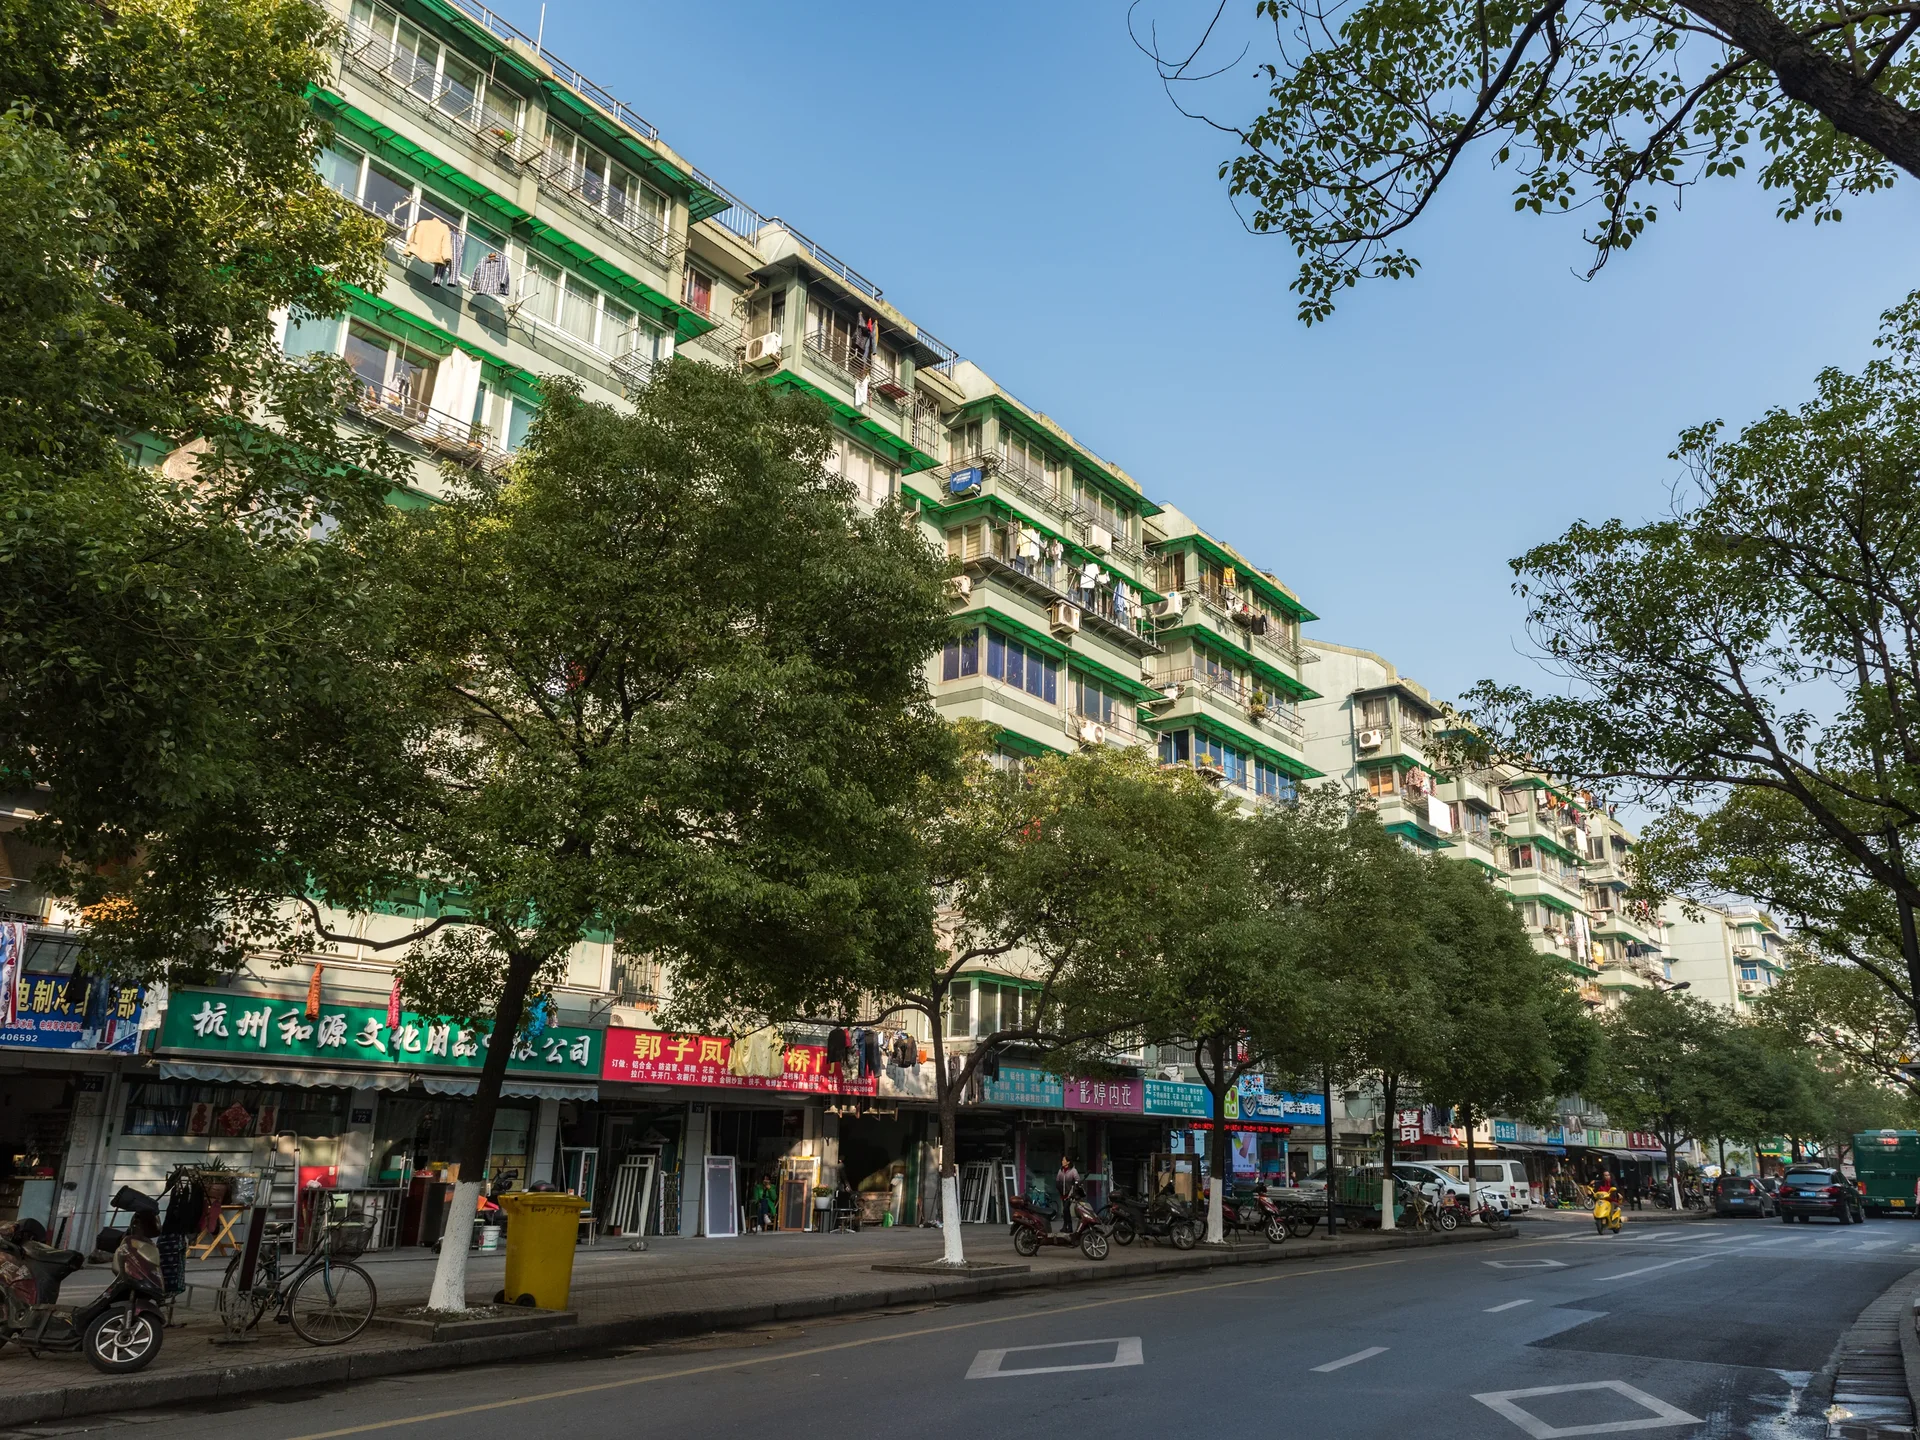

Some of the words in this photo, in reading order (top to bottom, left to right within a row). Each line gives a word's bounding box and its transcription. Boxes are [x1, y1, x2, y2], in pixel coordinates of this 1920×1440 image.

[0, 1033, 38, 1042] 406592
[1080, 1080, 1132, 1106] 彩婷内衣
[1400, 1110, 1421, 1144] 复印
